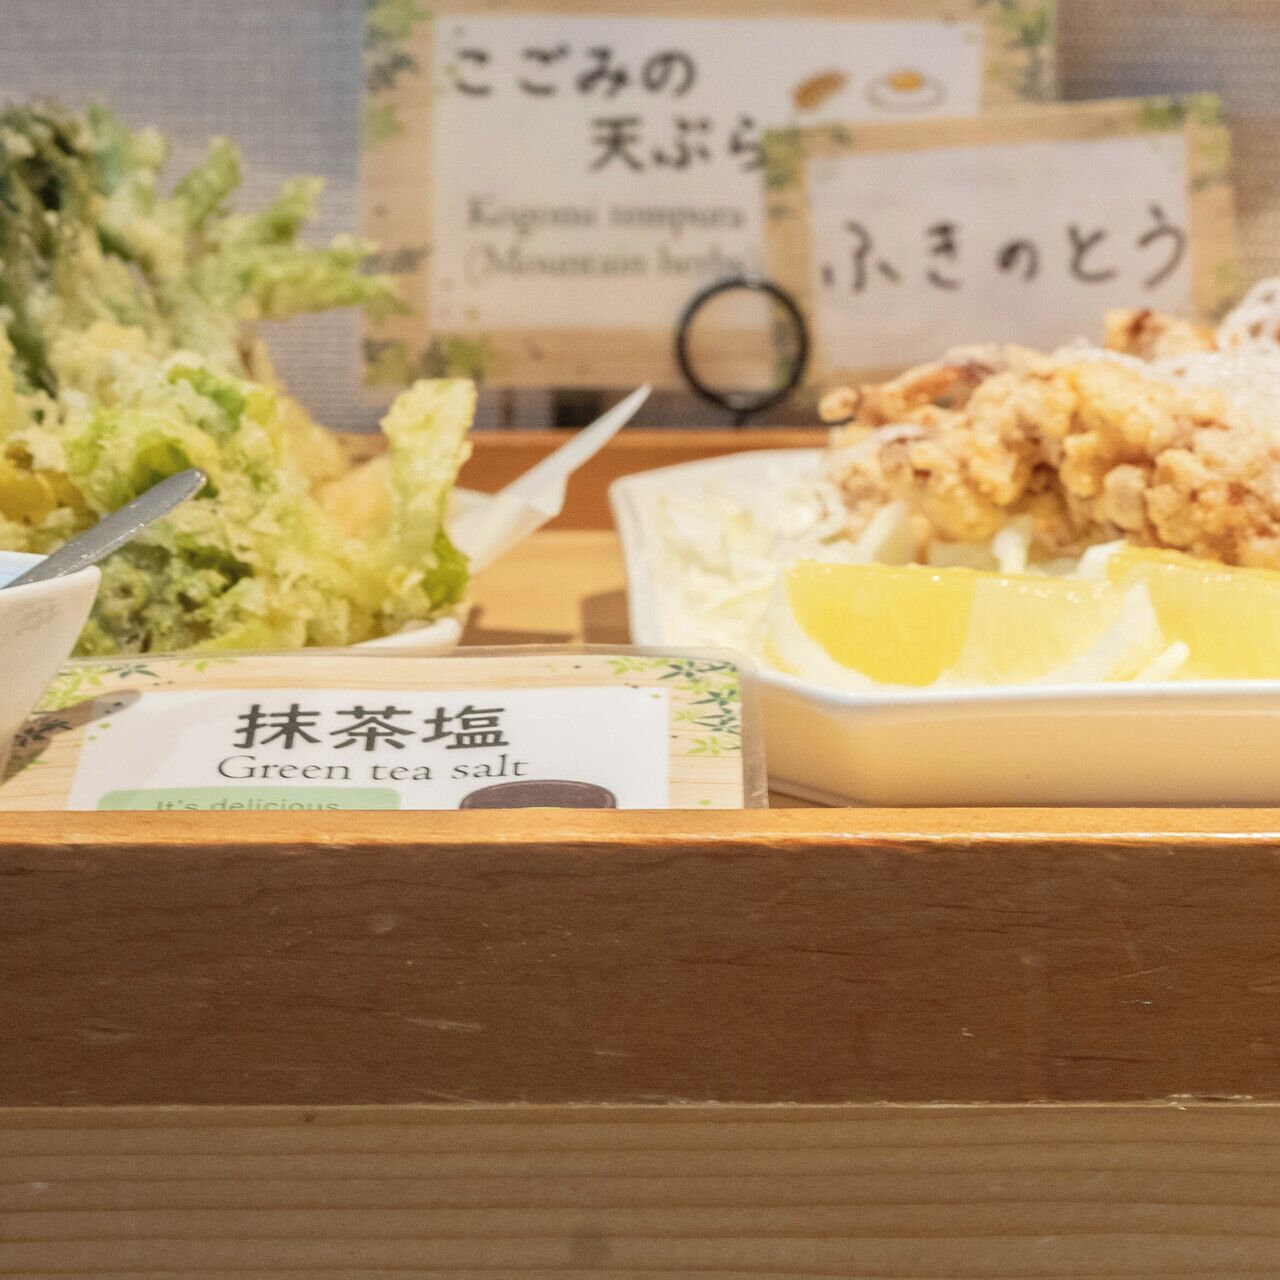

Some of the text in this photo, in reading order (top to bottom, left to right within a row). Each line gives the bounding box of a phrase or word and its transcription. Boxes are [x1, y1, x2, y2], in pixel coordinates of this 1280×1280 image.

[454, 44, 697, 97] こごみの
[590, 114, 765, 174] 天ぷら
[820, 205, 1188, 292] ふきのとう
[233, 703, 510, 752] 抹茶塩
[217, 753, 529, 781] Green tea salt
